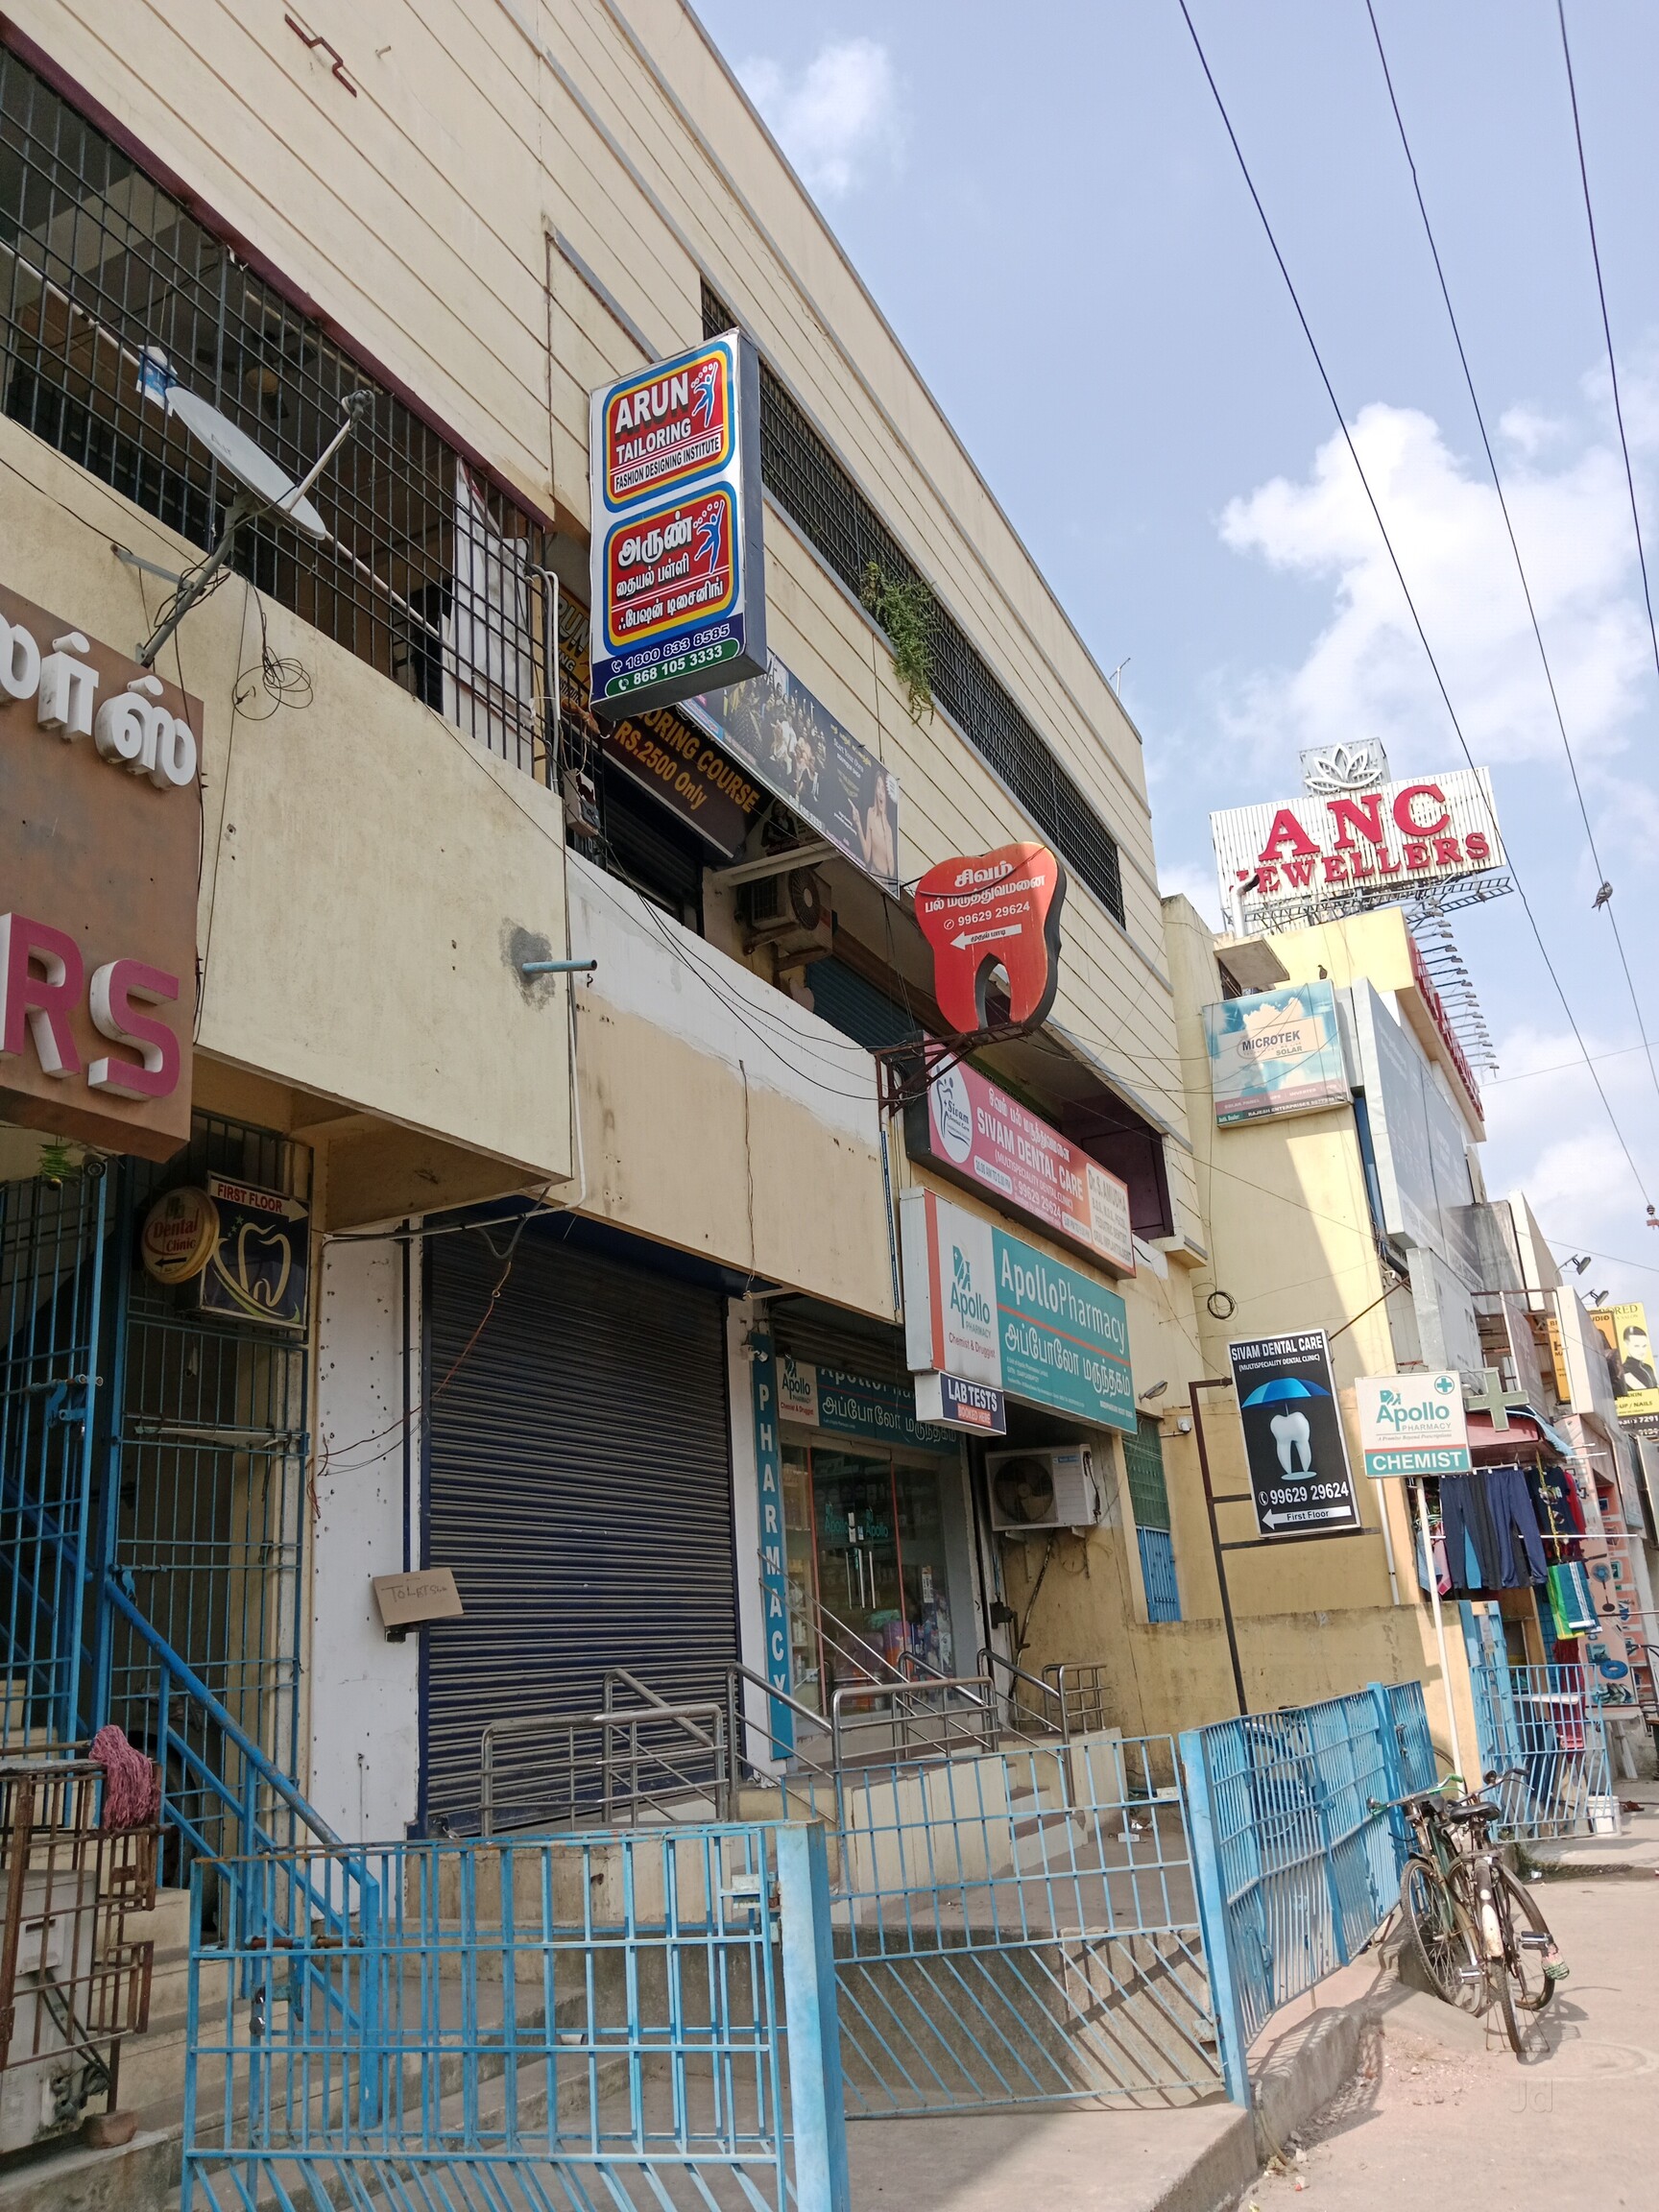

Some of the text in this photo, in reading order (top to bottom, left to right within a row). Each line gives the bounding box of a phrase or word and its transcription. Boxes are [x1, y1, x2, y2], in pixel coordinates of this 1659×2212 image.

[615, 372, 689, 434] ARUN
[616, 418, 691, 464] TAILORING
[615, 437, 719, 491] FASHION DESIGNING INSTITUTE
[618, 511, 692, 566] அருண்
[616, 553, 689, 596] தையல் பள்ளி
[667, 577, 723, 615] டிசைனிங்
[626, 624, 730, 669] 1800 833 8585
[634, 645, 723, 685] 868 105 3333
[614, 721, 677, 781] RS.2500
[675, 772, 708, 810] Only
[697, 750, 759, 813] COURSE
[1258, 783, 1451, 861] ANC
[954, 860, 1014, 887] சிவம்
[925, 876, 1046, 913] பல் மருத்துவமனை
[958, 902, 1030, 926] 99629 29624
[1242, 1030, 1300, 1051] MICROTEK
[1276, 1046, 1303, 1056] SOLAR
[948, 1099, 969, 1124] Sivam
[976, 1107, 1083, 1201] SIVAM DENTAL CARE
[218, 1183, 282, 1213] FIRST FLOOR
[1018, 1181, 1040, 1206] 99629
[1042, 1196, 1062, 1219] 29624
[154, 1209, 199, 1238] Dental
[166, 1238, 196, 1253] Clinic
[950, 1281, 990, 1329] Apollo
[949, 1332, 996, 1359] Chemist & Druggist
[965, 1320, 991, 1340] PHARMACY
[1005, 1323, 1080, 1377] அப்போலோ
[1083, 1358, 1130, 1397] மருந்தகம்
[1232, 1335, 1323, 1361] SIVAM DENTAL CARE
[1238, 1354, 1320, 1372] (MULTISPECIALITY DENTAL CLINIC)
[781, 1373, 810, 1400] Apollo
[948, 1379, 967, 1404] LAB
[968, 1386, 998, 1412] TESTS
[822, 1396, 901, 1430] அப்போலோ
[958, 1405, 991, 1425] BOOKED HERE
[1376, 1402, 1450, 1431] Apollo
[1402, 1423, 1452, 1431] PHARMACY
[1373, 1452, 1462, 1471] CHEMIST
[1269, 1481, 1349, 1504] 99629 29624
[1286, 1510, 1329, 1522] First Floor
[757, 1382, 787, 1705] PHARMACY
